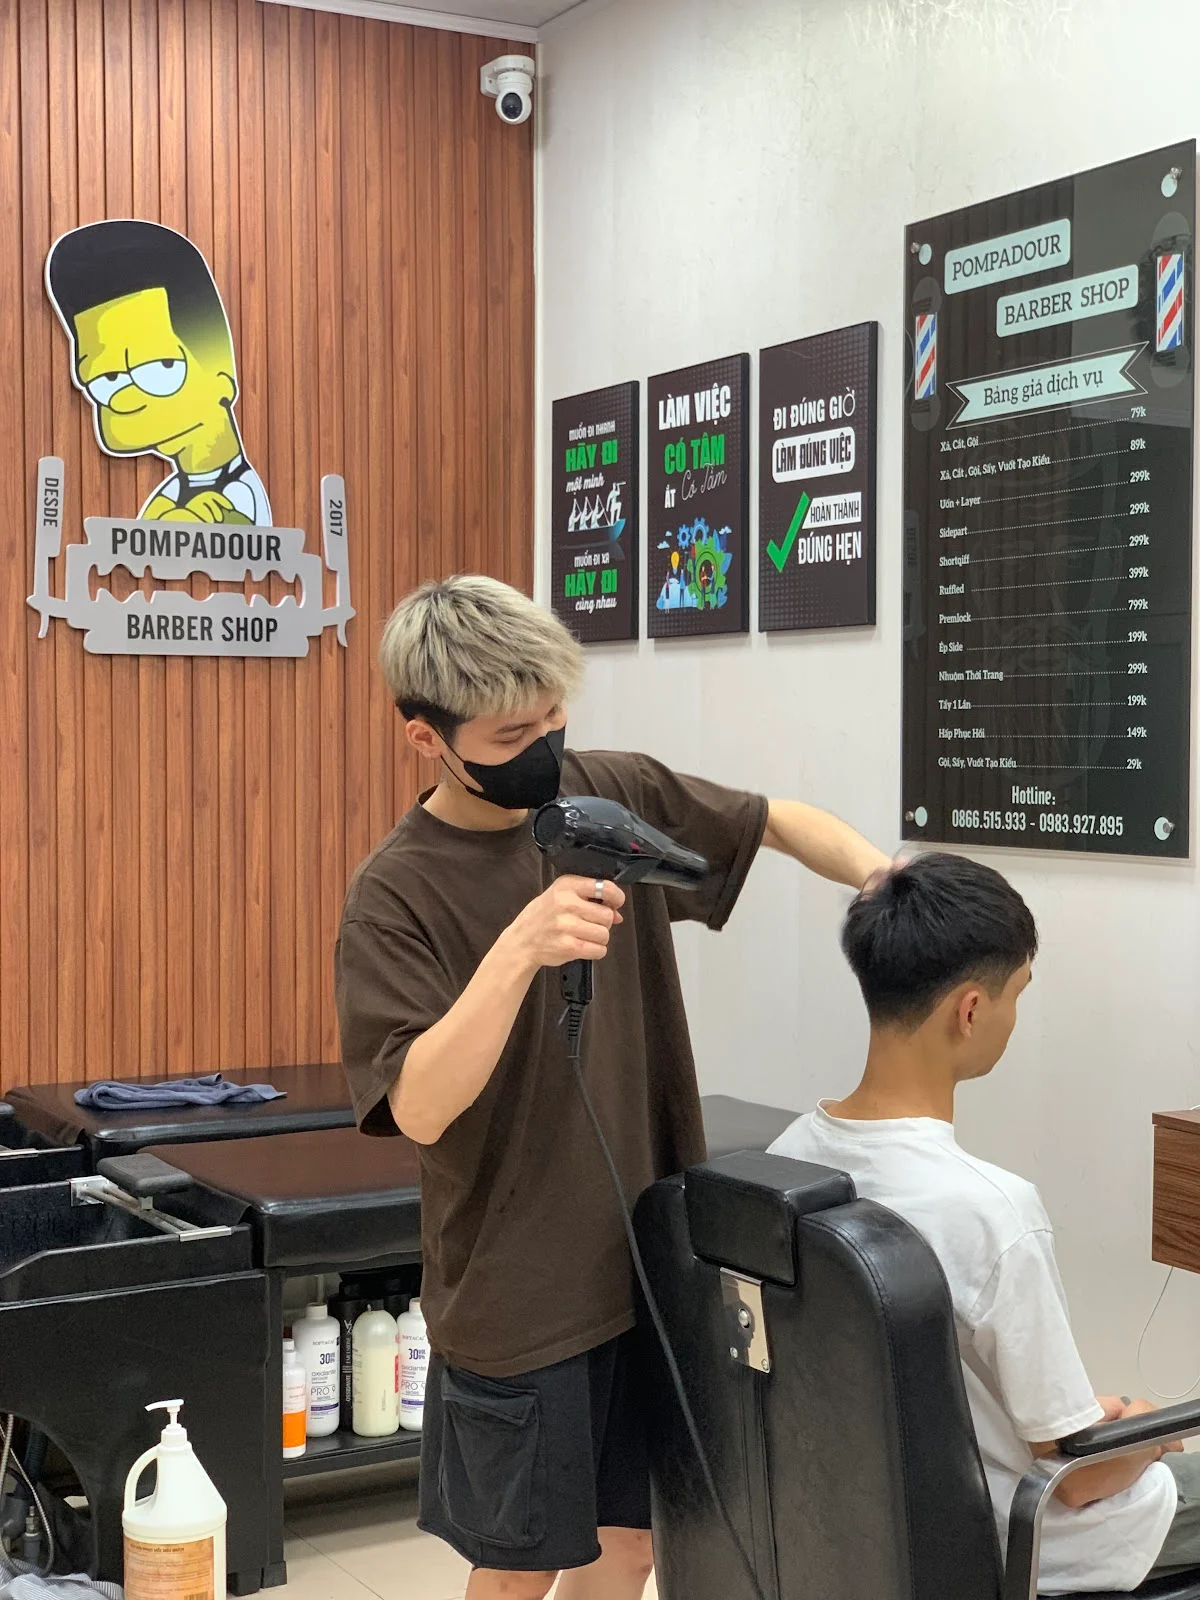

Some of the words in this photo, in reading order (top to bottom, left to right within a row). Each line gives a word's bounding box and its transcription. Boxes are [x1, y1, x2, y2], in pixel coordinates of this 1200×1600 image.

[952, 234, 1062, 281] POMPADOUR
[1004, 291, 1073, 325] BARBER
[1080, 277, 1130, 307] SHOP
[983, 385, 1019, 406] Bảng
[1022, 379, 1043, 402] giá
[1046, 370, 1079, 395] dịch
[1083, 370, 1103, 388] vụ
[658, 393, 690, 431] LÀM
[694, 382, 731, 426] VIỆC
[773, 406, 787, 431] ĐI
[790, 396, 826, 428] ĐÚNG
[829, 386, 856, 420] GIỜ
[1130, 406, 1146, 419] 79k
[587, 425, 595, 438] ĐI
[565, 442, 598, 473] HÃY
[601, 439, 618, 466] ĐI
[664, 437, 686, 475] CÓ
[690, 431, 725, 470] TÂM
[776, 442, 796, 473] LÀM
[799, 438, 827, 469] ĐÚNG
[829, 432, 852, 469] VIỆC
[1130, 438, 1146, 451] 89k
[960, 496, 981, 508] Layer
[1129, 470, 1150, 483] 299k
[43, 477, 59, 528] DESDE
[810, 502, 832, 523] HOÀN
[833, 499, 860, 520] THÀNH
[329, 499, 343, 537] 2017
[939, 526, 968, 538] Sidepart
[1129, 502, 1150, 515] 299k
[111, 527, 281, 561] POMPADOUR
[798, 531, 833, 565] ĐÚNG
[835, 531, 862, 565] HẸN
[1129, 534, 1149, 547] 299k
[565, 568, 597, 597] HÃY
[601, 568, 617, 593] ĐI
[1128, 567, 1148, 579] 399k
[595, 595, 617, 609] nhau
[939, 612, 972, 624] Premlock
[1128, 599, 1148, 611] 799k
[127, 614, 213, 642] BARBER
[221, 617, 278, 643] SHOP
[948, 641, 964, 652] Side
[1127, 631, 1147, 642] 199k
[982, 670, 1004, 682] Trang
[1127, 663, 1147, 674] 299k
[952, 700, 957, 710] 1
[1127, 695, 1147, 706] 199k
[1126, 727, 1147, 738] 149k
[1126, 759, 1142, 770] 29k
[1011, 785, 1056, 806] Hotline:
[952, 809, 1026, 831] 0866.515.933
[1039, 812, 1123, 836] 0983.927.895
[320, 1352, 331, 1365] 30
[408, 1348, 419, 1360] 30
[310, 1386, 330, 1396] PRO
[401, 1382, 418, 1391] PRO
